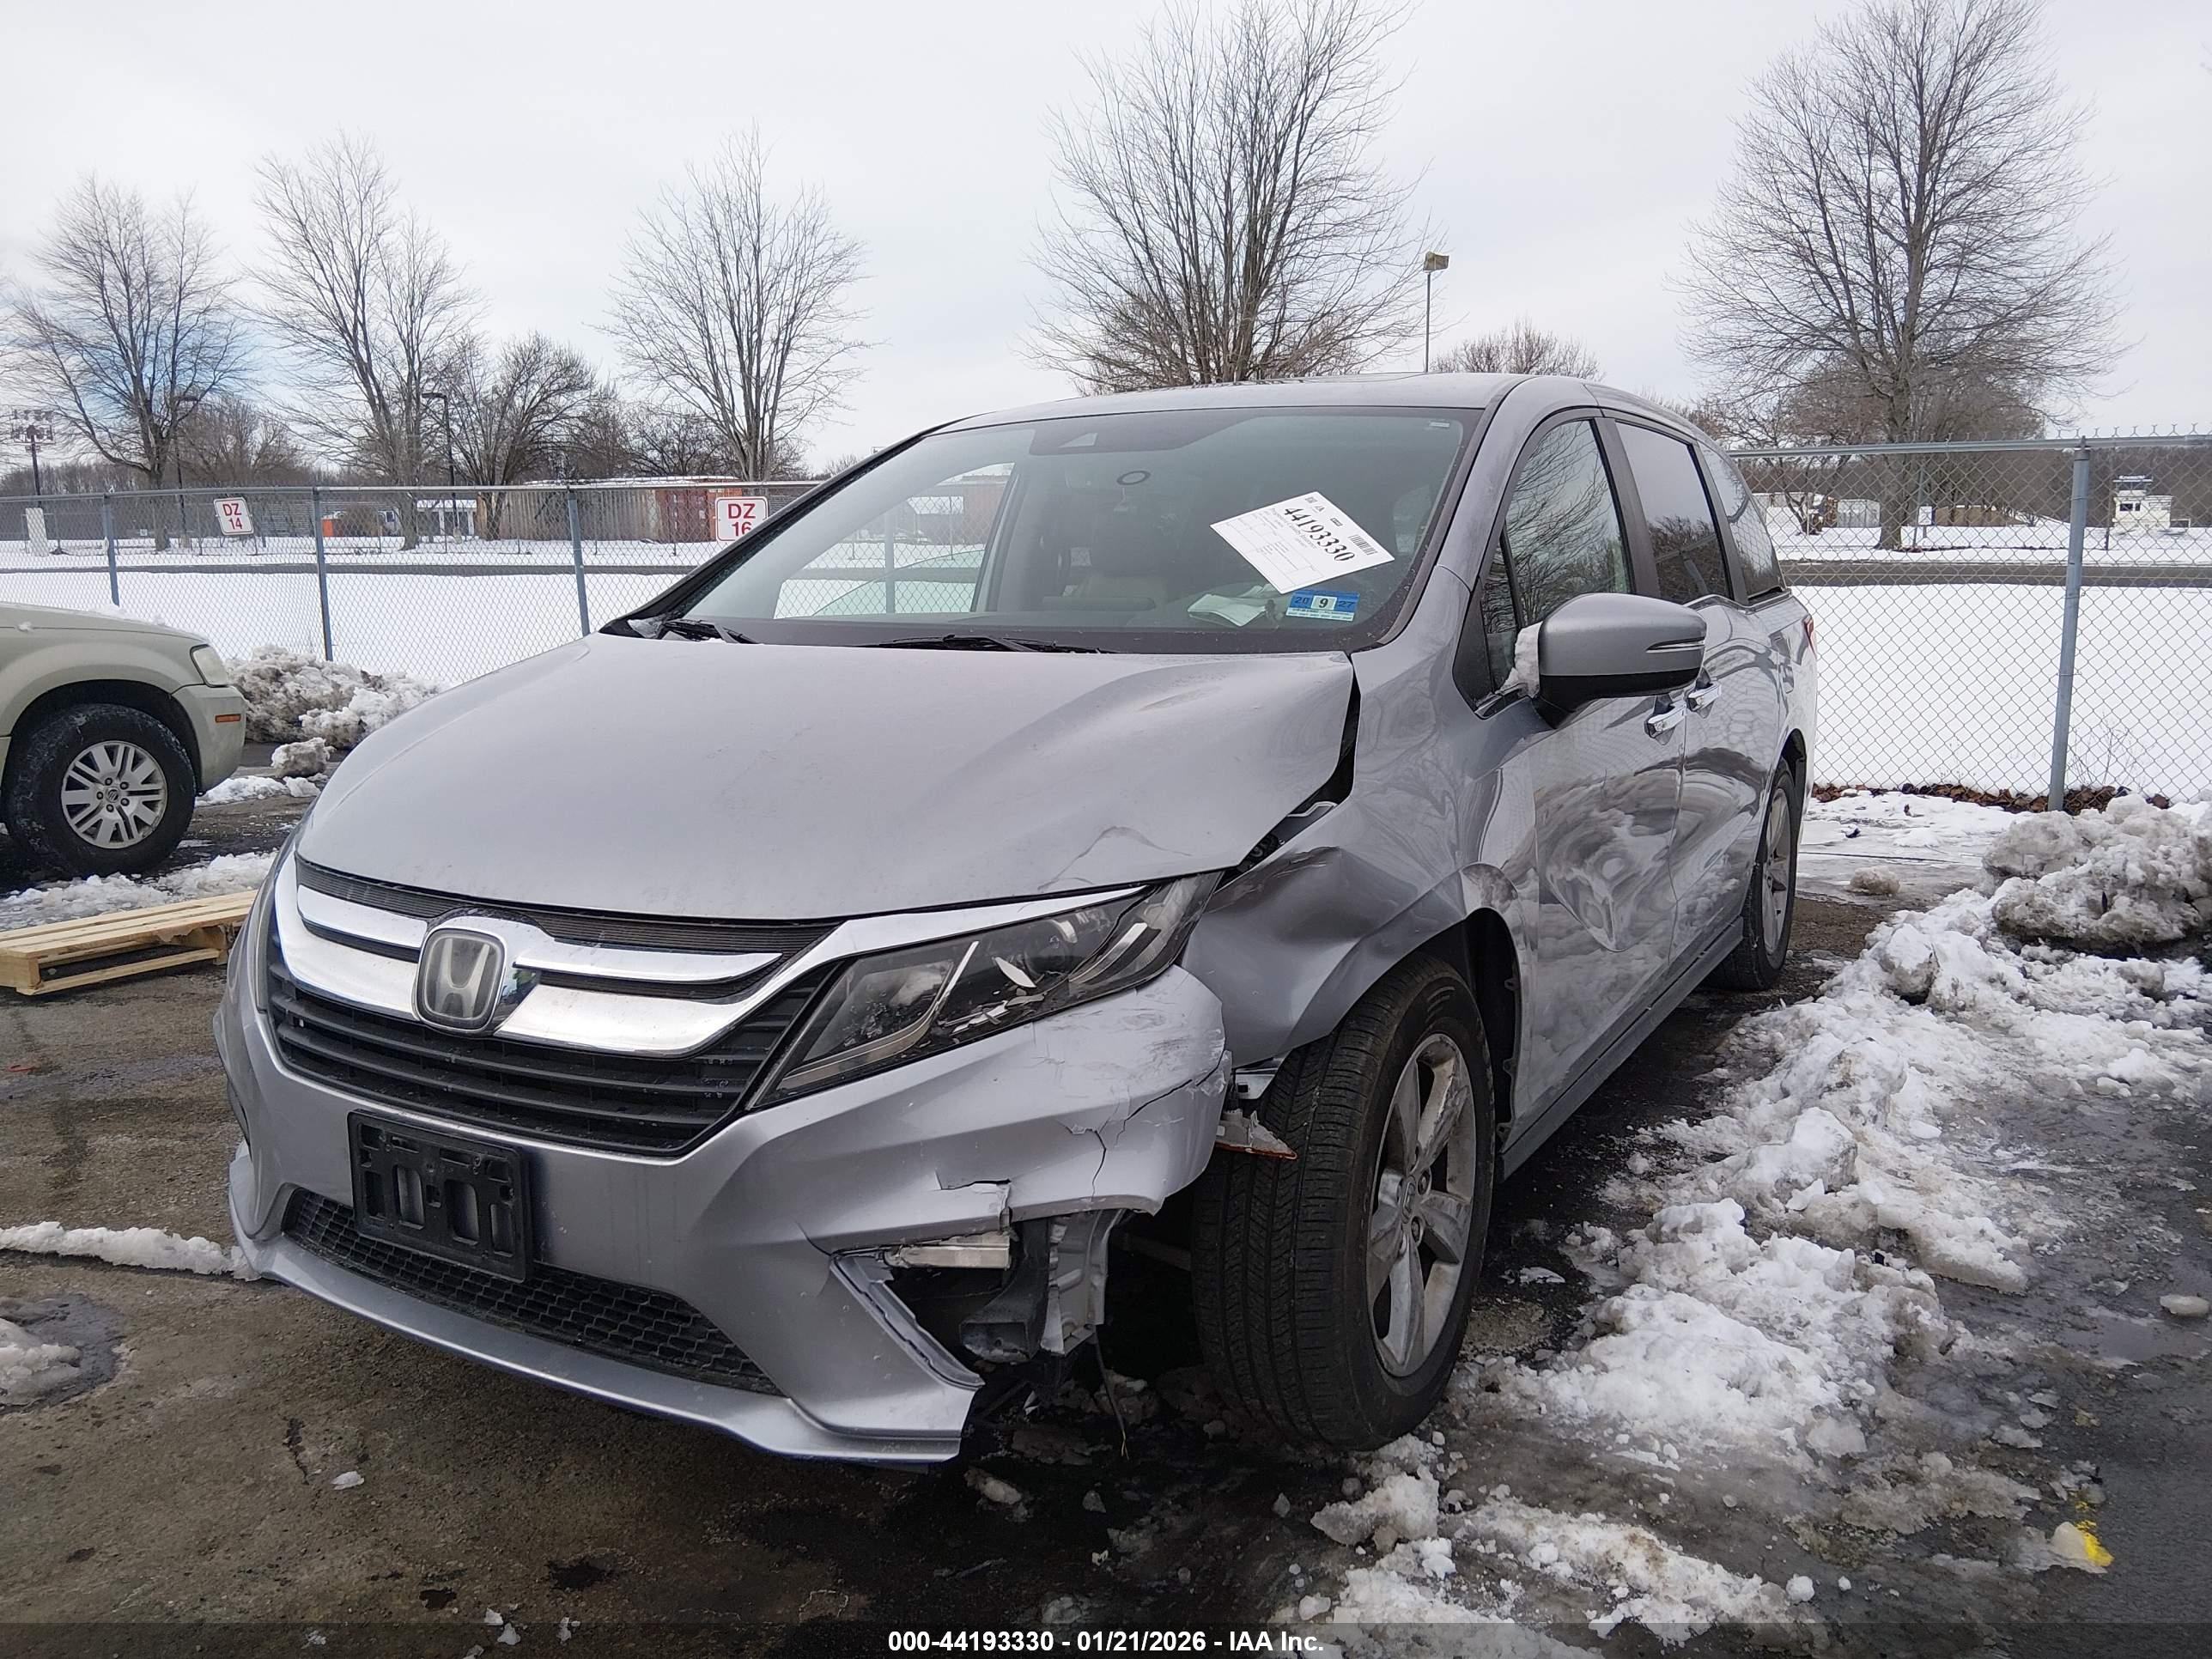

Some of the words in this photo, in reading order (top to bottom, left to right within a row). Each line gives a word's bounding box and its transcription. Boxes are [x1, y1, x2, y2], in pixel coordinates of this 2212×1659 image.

[222, 503, 242, 516] DZ
[727, 503, 757, 520] DZ
[228, 517, 243, 530] 14
[1284, 507, 1355, 561] 44193330
[1295, 596, 1310, 605] 20
[1318, 598, 1329, 608] 9
